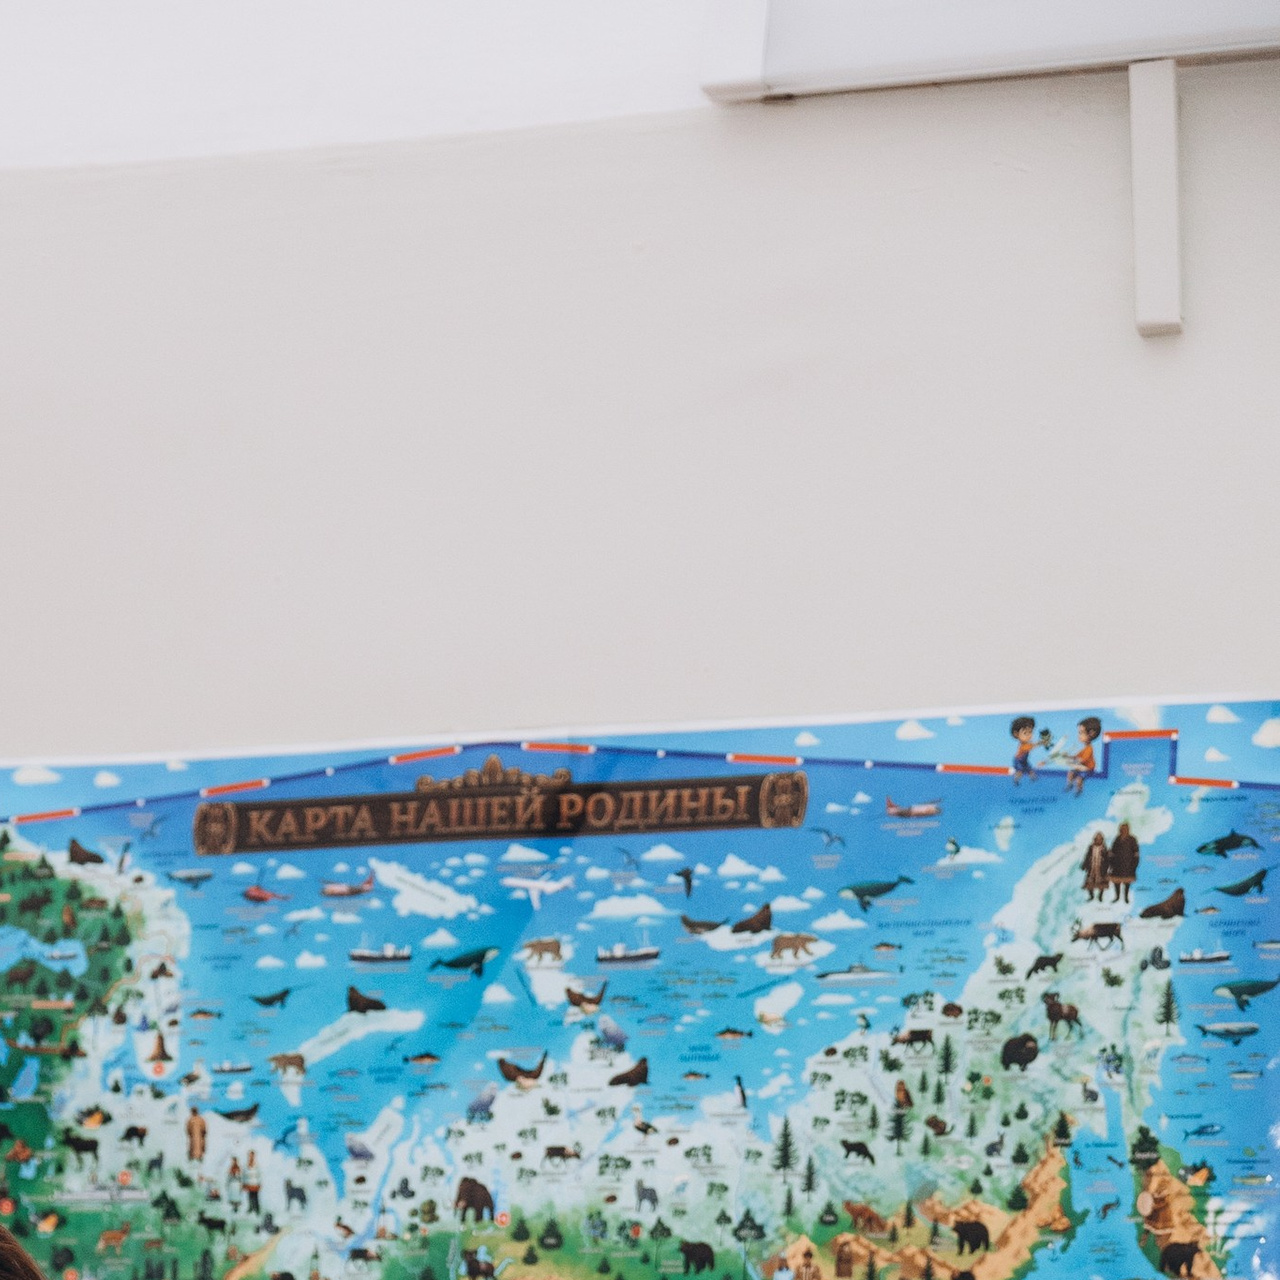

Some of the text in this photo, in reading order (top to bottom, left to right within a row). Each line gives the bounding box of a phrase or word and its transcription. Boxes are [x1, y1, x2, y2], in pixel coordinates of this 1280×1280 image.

[246, 784, 753, 845] КАРТА НАШЕЙ РОДИНЫ
